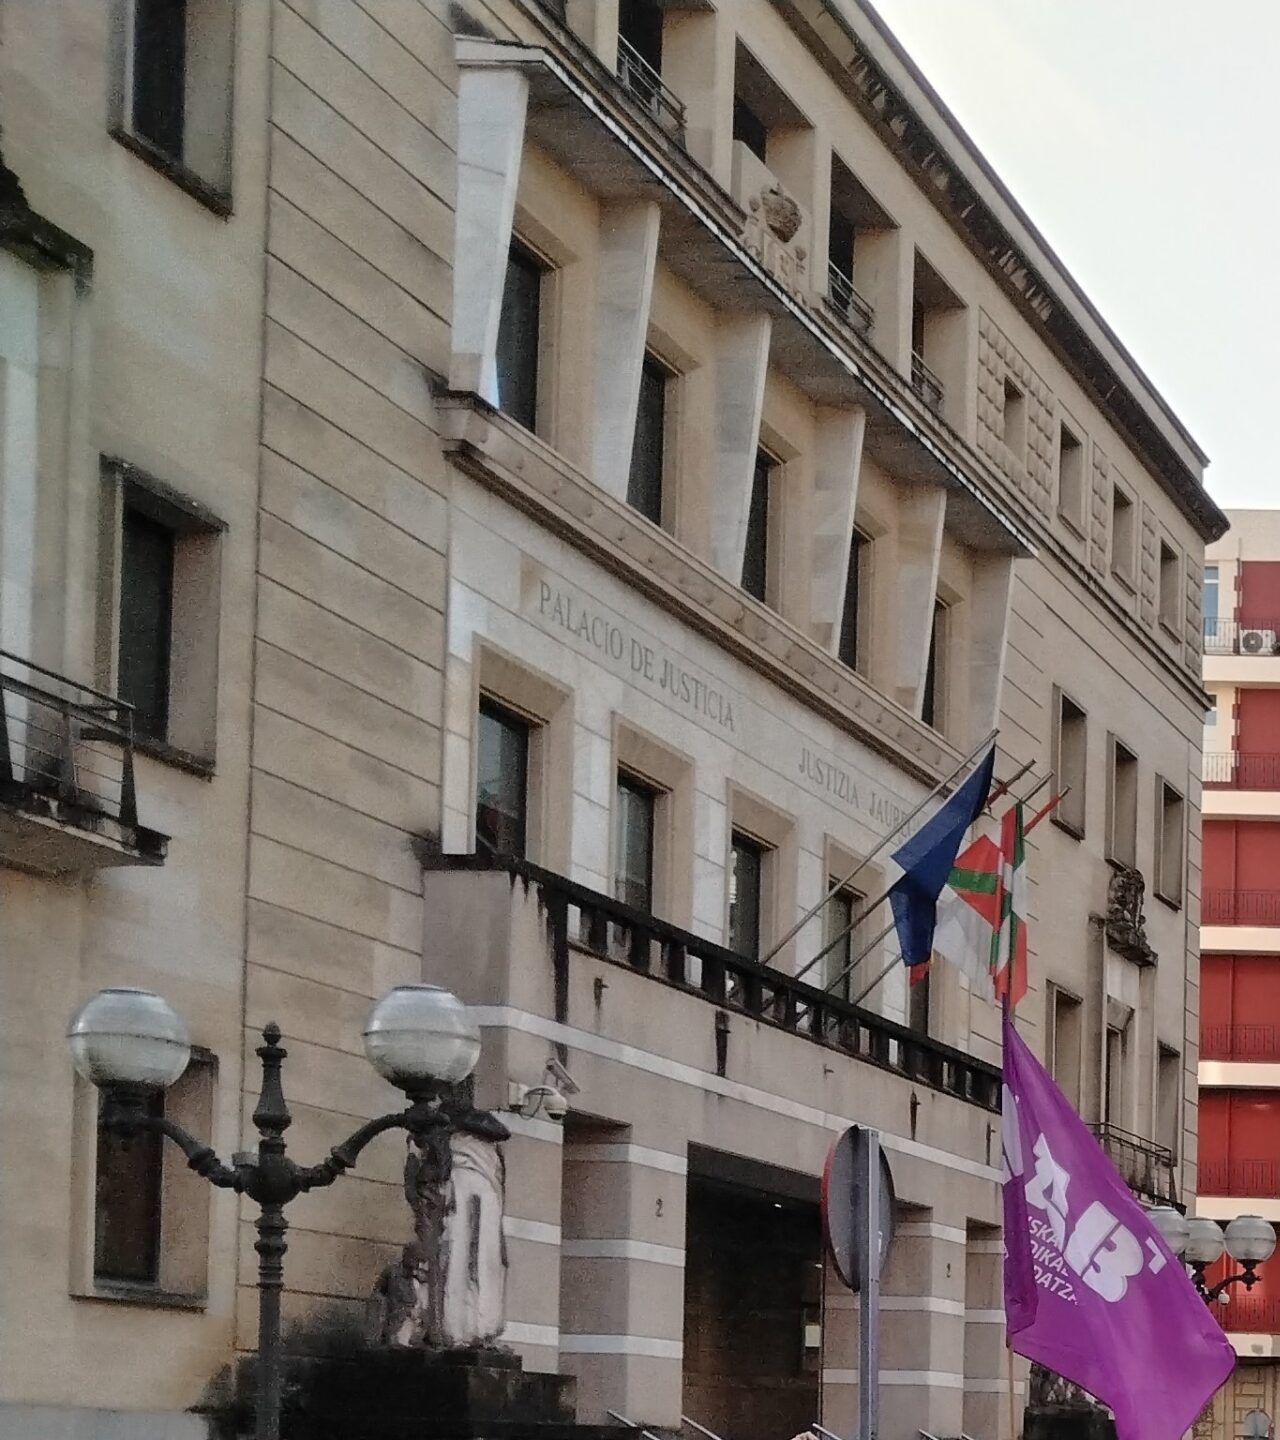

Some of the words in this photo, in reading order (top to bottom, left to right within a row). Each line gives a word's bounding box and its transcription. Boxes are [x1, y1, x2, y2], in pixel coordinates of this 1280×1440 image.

[540, 580, 623, 660] PALACIO
[631, 638, 654, 681] DE
[660, 658, 735, 732] JUSTICIA
[799, 748, 859, 809] JUSTIZIA
